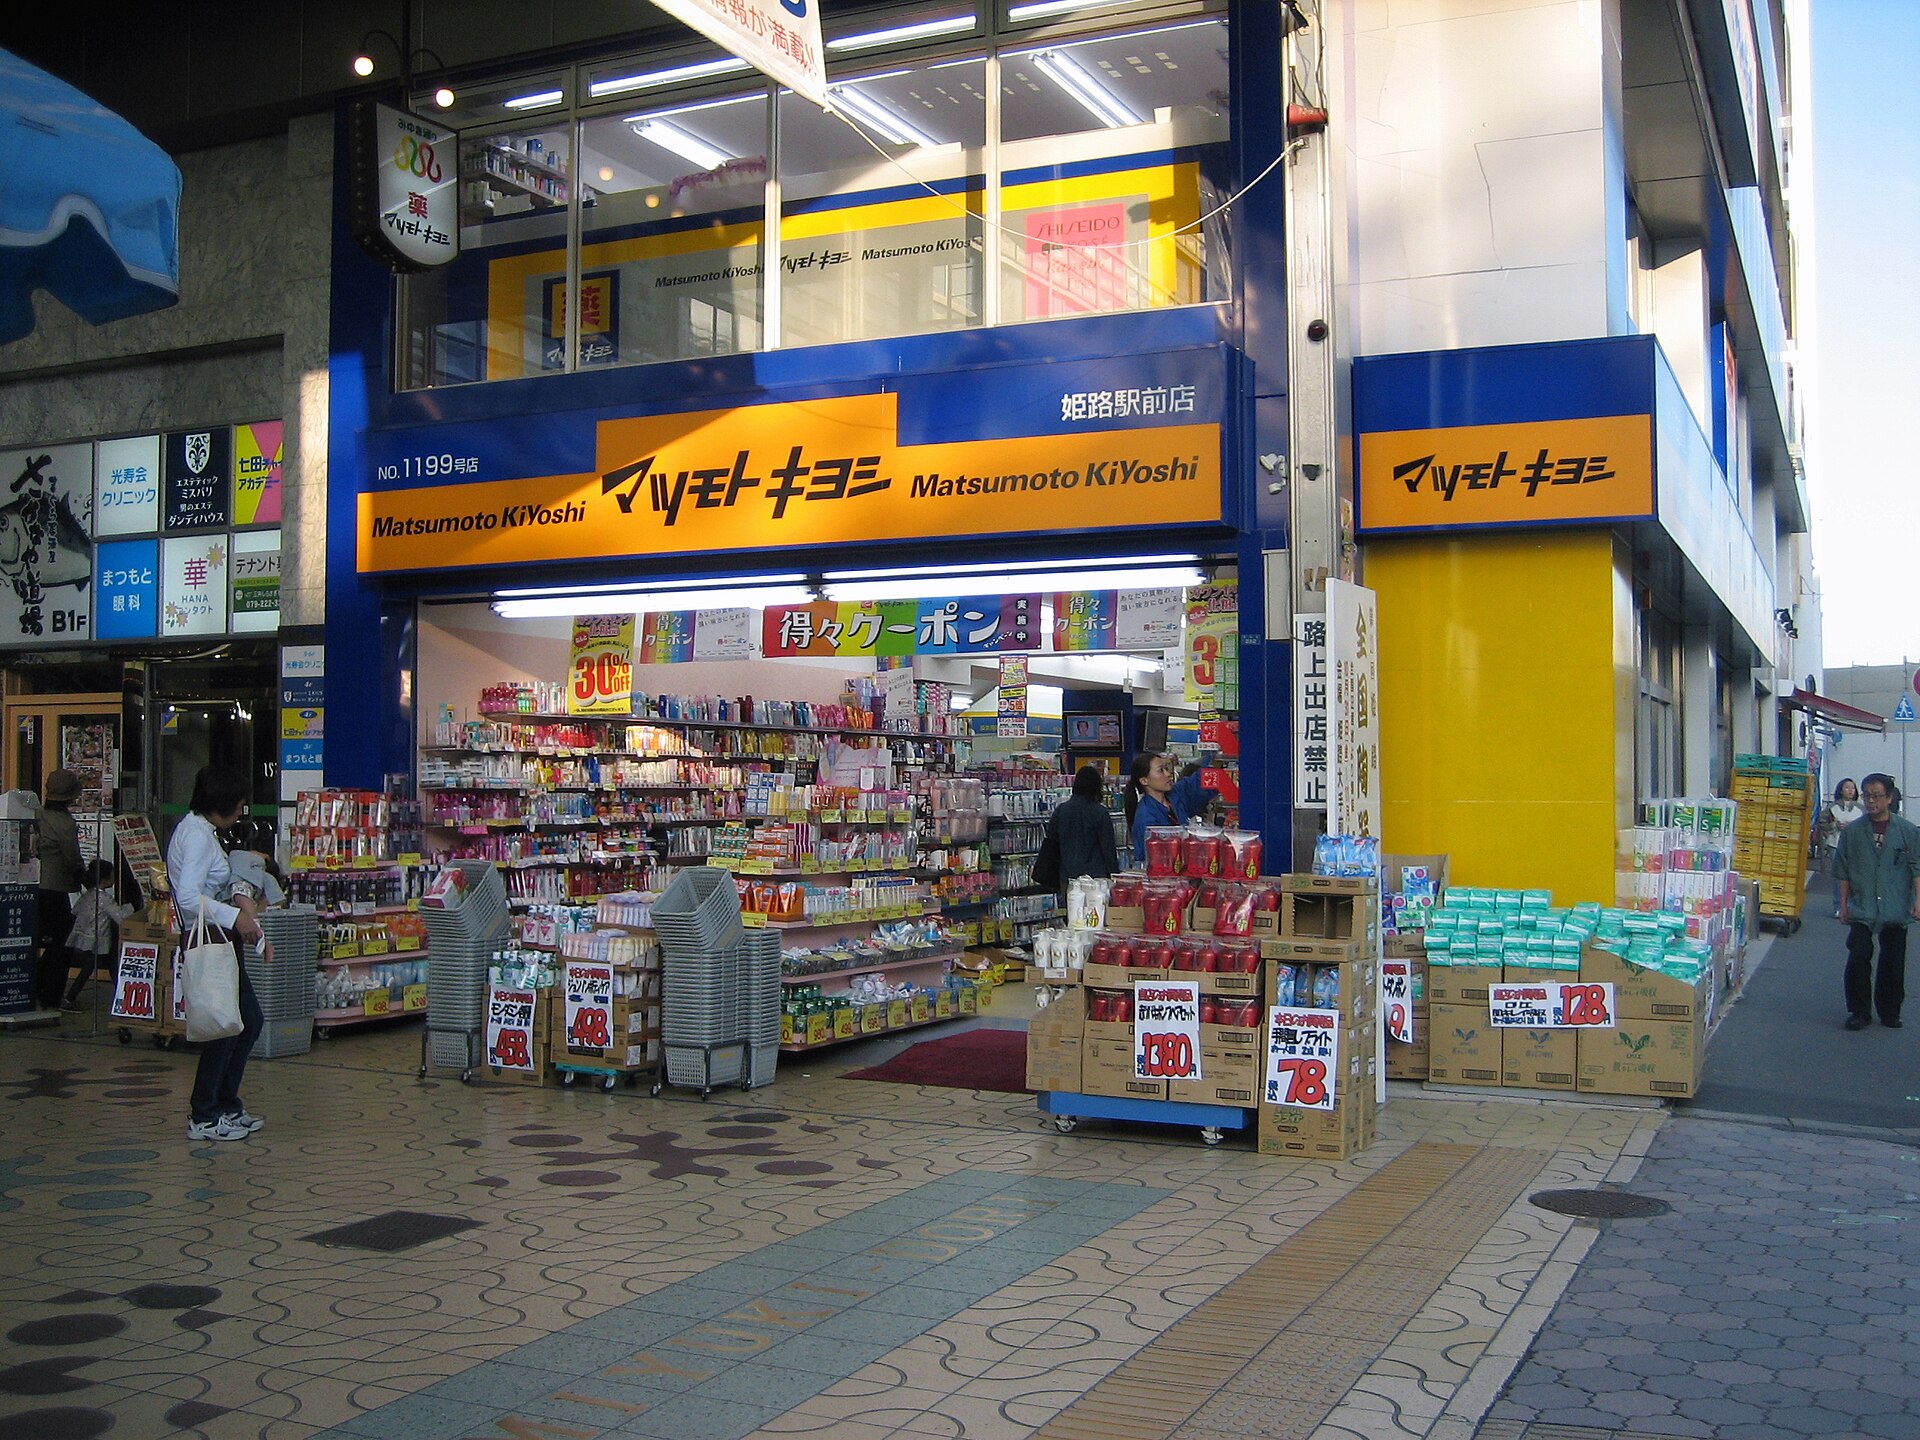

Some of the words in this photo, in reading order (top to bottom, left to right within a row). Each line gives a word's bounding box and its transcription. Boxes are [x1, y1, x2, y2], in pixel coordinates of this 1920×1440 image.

[408, 191, 428, 219] 薬
[384, 212, 451, 245] マツモトキヨシ
[1037, 216, 1120, 238] SHISEIDO
[861, 242, 933, 261] Matsumoto
[935, 237, 971, 252] KiYos
[654, 271, 720, 288] Matsumoto
[721, 263, 764, 281] KiYoshi
[1060, 384, 1196, 421] 姫路駅前店
[111, 466, 148, 484] 光寿会
[175, 475, 219, 488] エステティック
[238, 475, 280, 490] アカデミー
[601, 445, 892, 526] マツモトキヨシ
[910, 466, 1079, 498] Matsumoto
[1084, 455, 1200, 486] KiYoshi
[1393, 449, 1616, 502] マツモトキヨシ
[102, 487, 156, 507] クリニック
[180, 501, 213, 512] 男のエステ
[168, 511, 225, 527] ダンディハウス
[371, 508, 498, 538] Matsumoto
[500, 500, 586, 529] KiYoshi
[102, 567, 152, 587] まつもと
[184, 558, 208, 590] 華
[112, 594, 140, 612] 眼科
[181, 594, 209, 604] HANA
[1068, 596, 1101, 615] 得々
[52, 609, 87, 632] B1F
[656, 614, 683, 632] 得々
[778, 600, 1001, 649] 得々クーポン
[1015, 598, 1029, 642] 実施中
[1056, 613, 1114, 632] クーポン
[645, 631, 693, 647] クーポン
[574, 652, 629, 700] 30%
[612, 676, 630, 692] OFF
[1303, 620, 1327, 804] 路上出店禁止
[1559, 984, 1607, 1026] 128
[572, 1006, 608, 1046] 498
[496, 1028, 528, 1066] 458
[1142, 1032, 1193, 1077] 1380
[1277, 1058, 1327, 1104] 78
